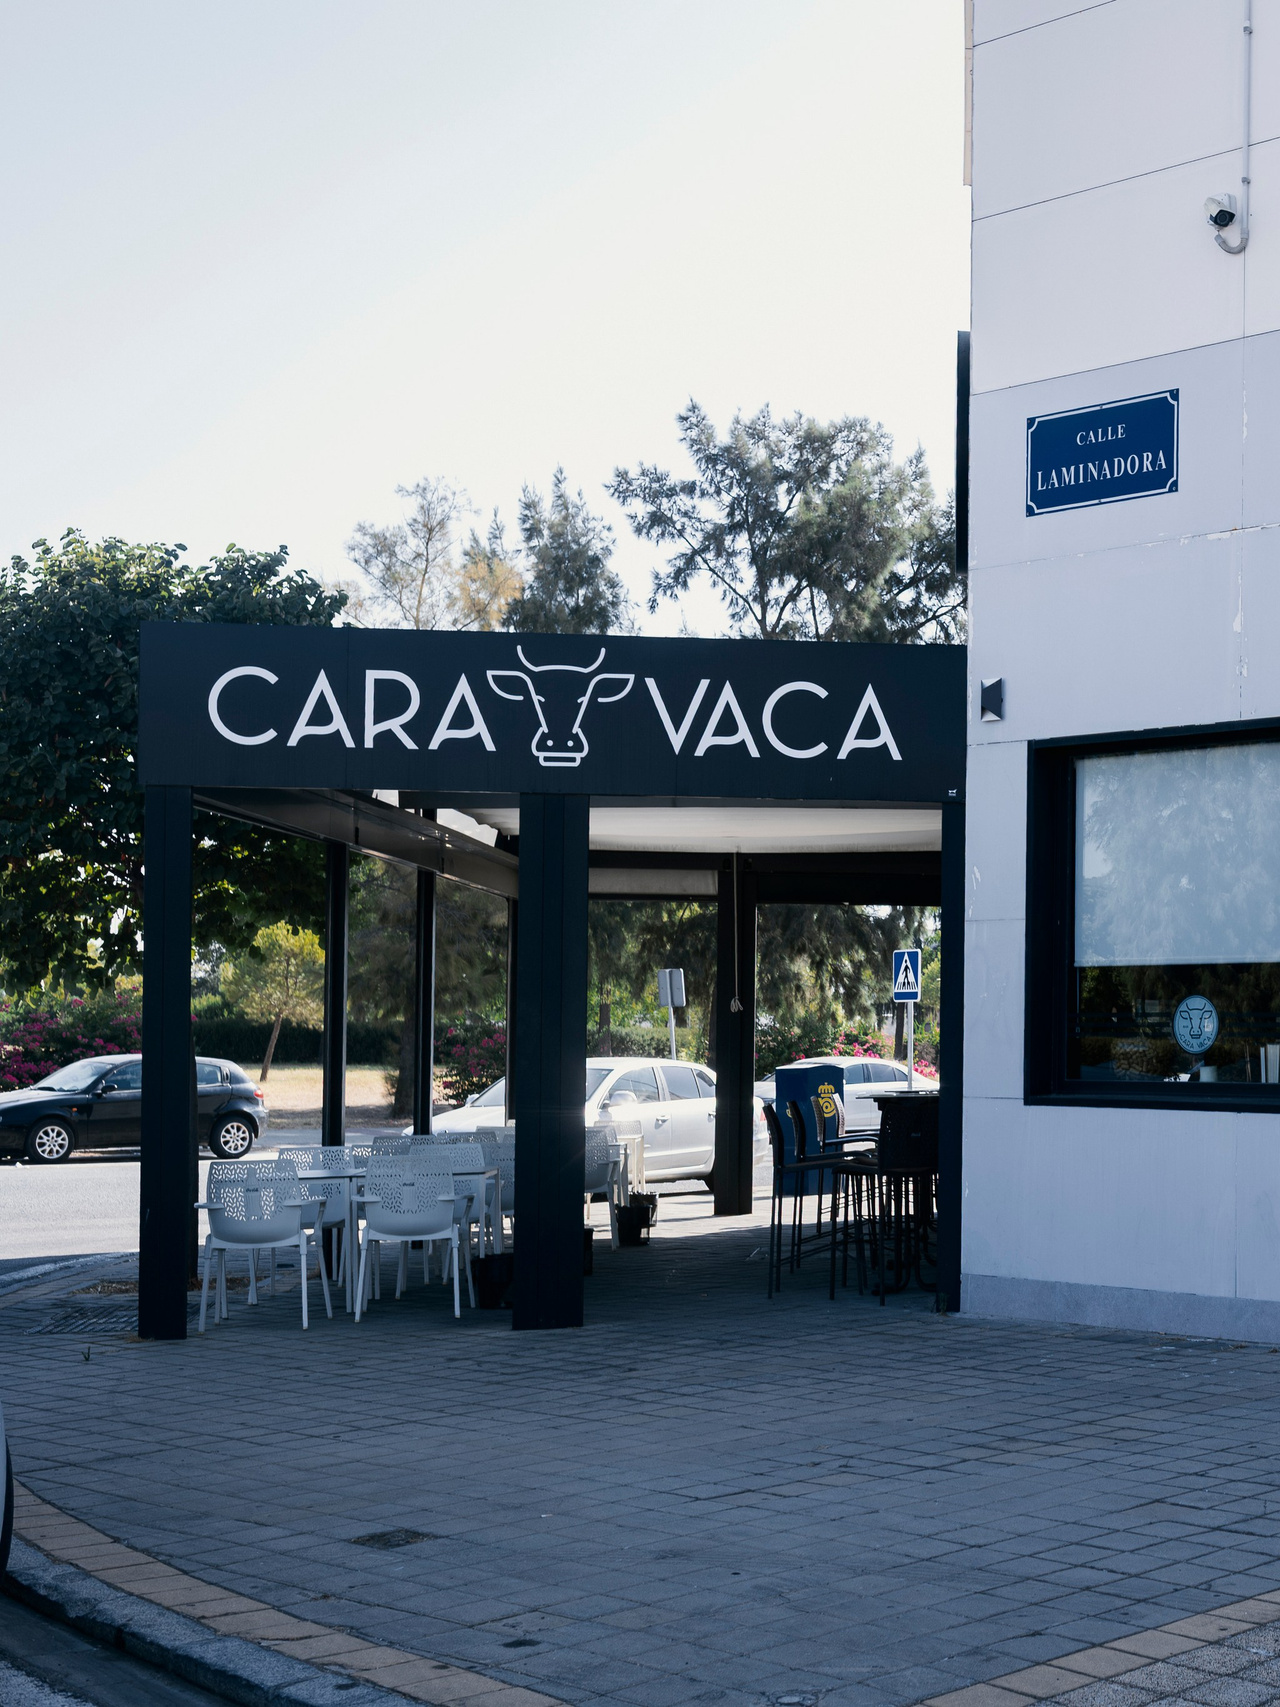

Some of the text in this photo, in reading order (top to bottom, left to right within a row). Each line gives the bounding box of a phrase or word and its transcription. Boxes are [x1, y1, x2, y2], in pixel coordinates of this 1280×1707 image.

[1076, 424, 1127, 446] CALLE
[1037, 450, 1167, 491] LAMINADORA
[208, 665, 902, 761] CARA VACA
[1180, 1034, 1212, 1050] CARA VACA
